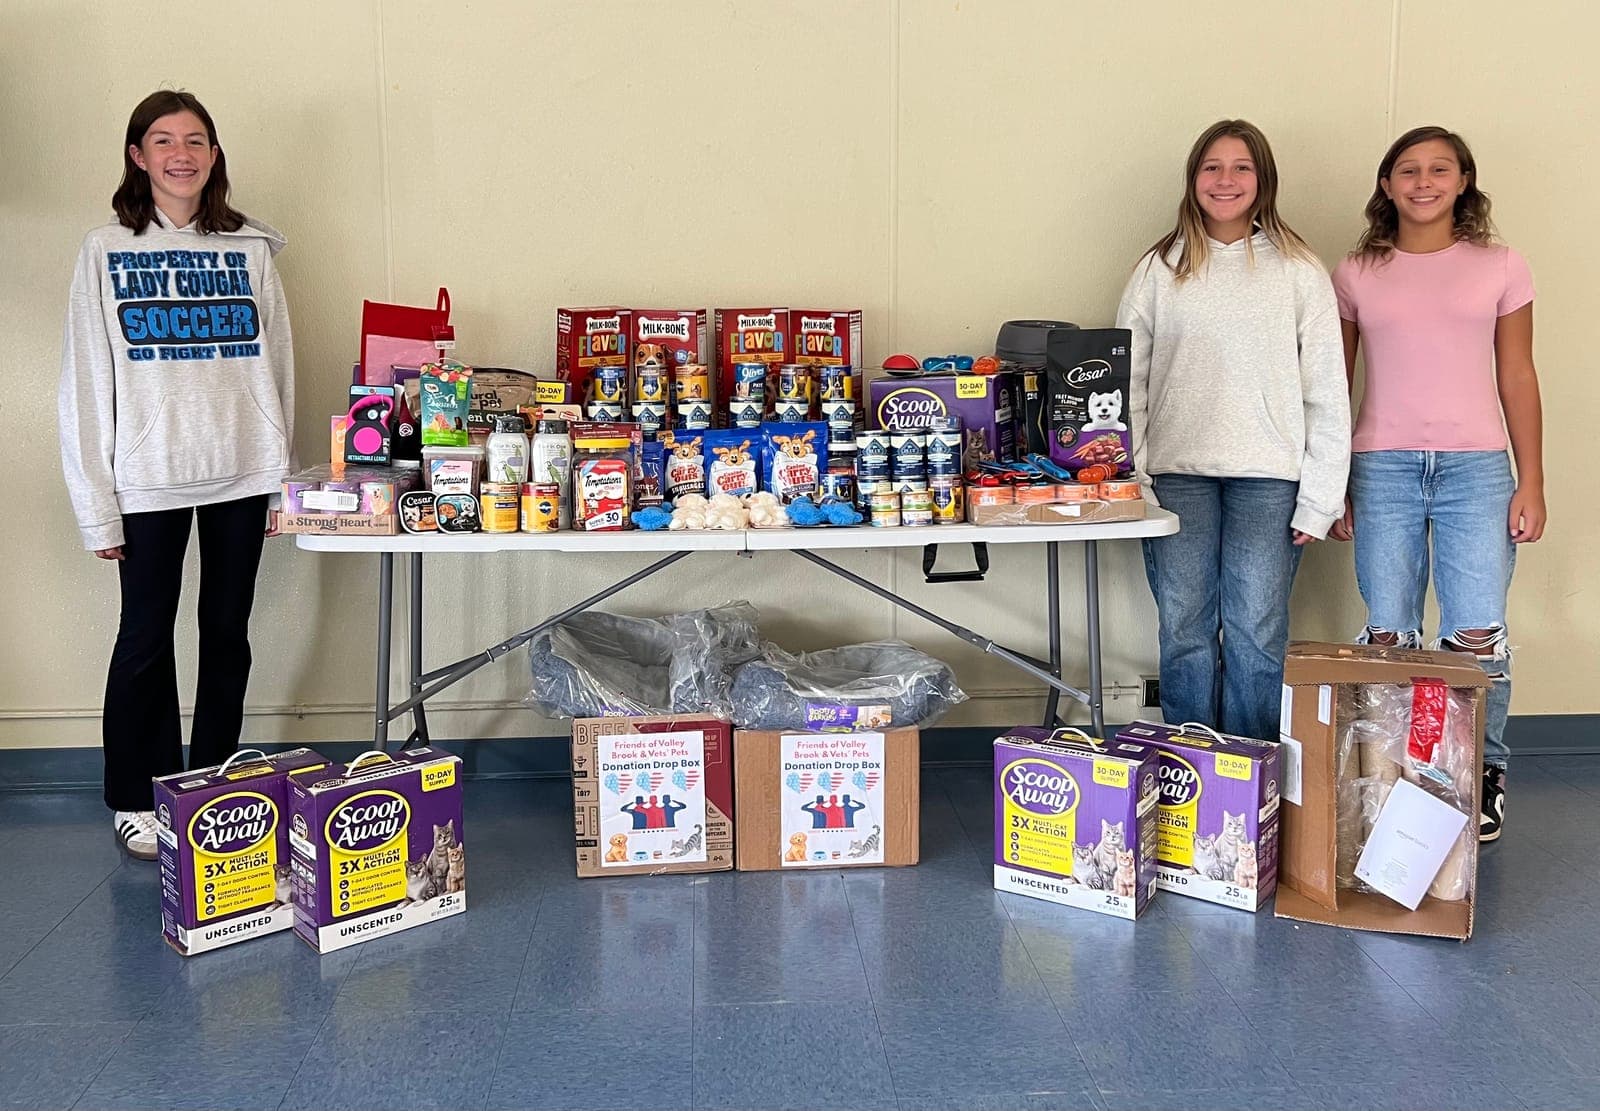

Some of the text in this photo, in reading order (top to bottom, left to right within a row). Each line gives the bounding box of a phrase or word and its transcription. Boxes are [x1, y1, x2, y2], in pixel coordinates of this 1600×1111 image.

[107, 250, 247, 272] PROPERTY OF
[111, 269, 253, 300] LADY COUGAR
[123, 304, 254, 340] SOCCER
[127, 343, 260, 361] GO FIGHT WIN
[1067, 367, 1108, 384] Cesar
[471, 390, 497, 400] ural
[537, 386, 562, 394] 30-DAY
[886, 397, 941, 415] Scoop
[434, 474, 468, 486] Temptations
[585, 475, 622, 487] Temptations
[717, 472, 747, 486] Carry
[407, 496, 432, 506] Cesar
[296, 517, 338, 530] Strong
[341, 518, 371, 527] Heart
[605, 512, 619, 522] 30
[614, 741, 646, 749] Friends
[659, 739, 685, 750] Valley
[830, 741, 839, 749] of
[840, 740, 866, 750] Valley
[611, 751, 637, 759] Brook
[649, 749, 669, 757] Vets'
[602, 761, 650, 772] Donation
[653, 761, 678, 770] Drop
[785, 761, 832, 770] Donation
[834, 761, 860, 771] Drop
[1219, 759, 1249, 770] 30-DAY
[425, 769, 452, 782] 30-DAY
[1096, 766, 1126, 778] 30-DAY
[1159, 766, 1196, 784] oop
[429, 778, 448, 787] SUPPLY
[1010, 766, 1074, 792] Scoop
[1011, 784, 1069, 814] Away
[1159, 782, 1189, 805] ay
[199, 801, 272, 831] Scoop
[336, 800, 404, 829] Scoop
[1160, 811, 1188, 820] ULTI-CAT
[1012, 815, 1029, 830] 3X
[1033, 819, 1067, 830] MULTI-CAT
[1160, 817, 1188, 828] CTION
[199, 820, 268, 850] Away
[336, 817, 401, 847] Away
[1033, 825, 1066, 838] ACTION
[230, 851, 268, 865] MULTI-CAT
[364, 848, 400, 861] MULTI-CAT
[230, 858, 268, 872] ACTION
[340, 858, 360, 875] 3X
[364, 855, 400, 870] ACTION
[204, 861, 226, 878] 3X
[1010, 875, 1069, 894] UNSCENTED
[1158, 873, 1188, 885] ENTED
[1225, 887, 1240, 897] 25
[439, 896, 453, 909] 25
[1106, 895, 1120, 906] 25
[205, 916, 272, 940] UNSCENTED
[340, 912, 403, 937] UNSCENTED
